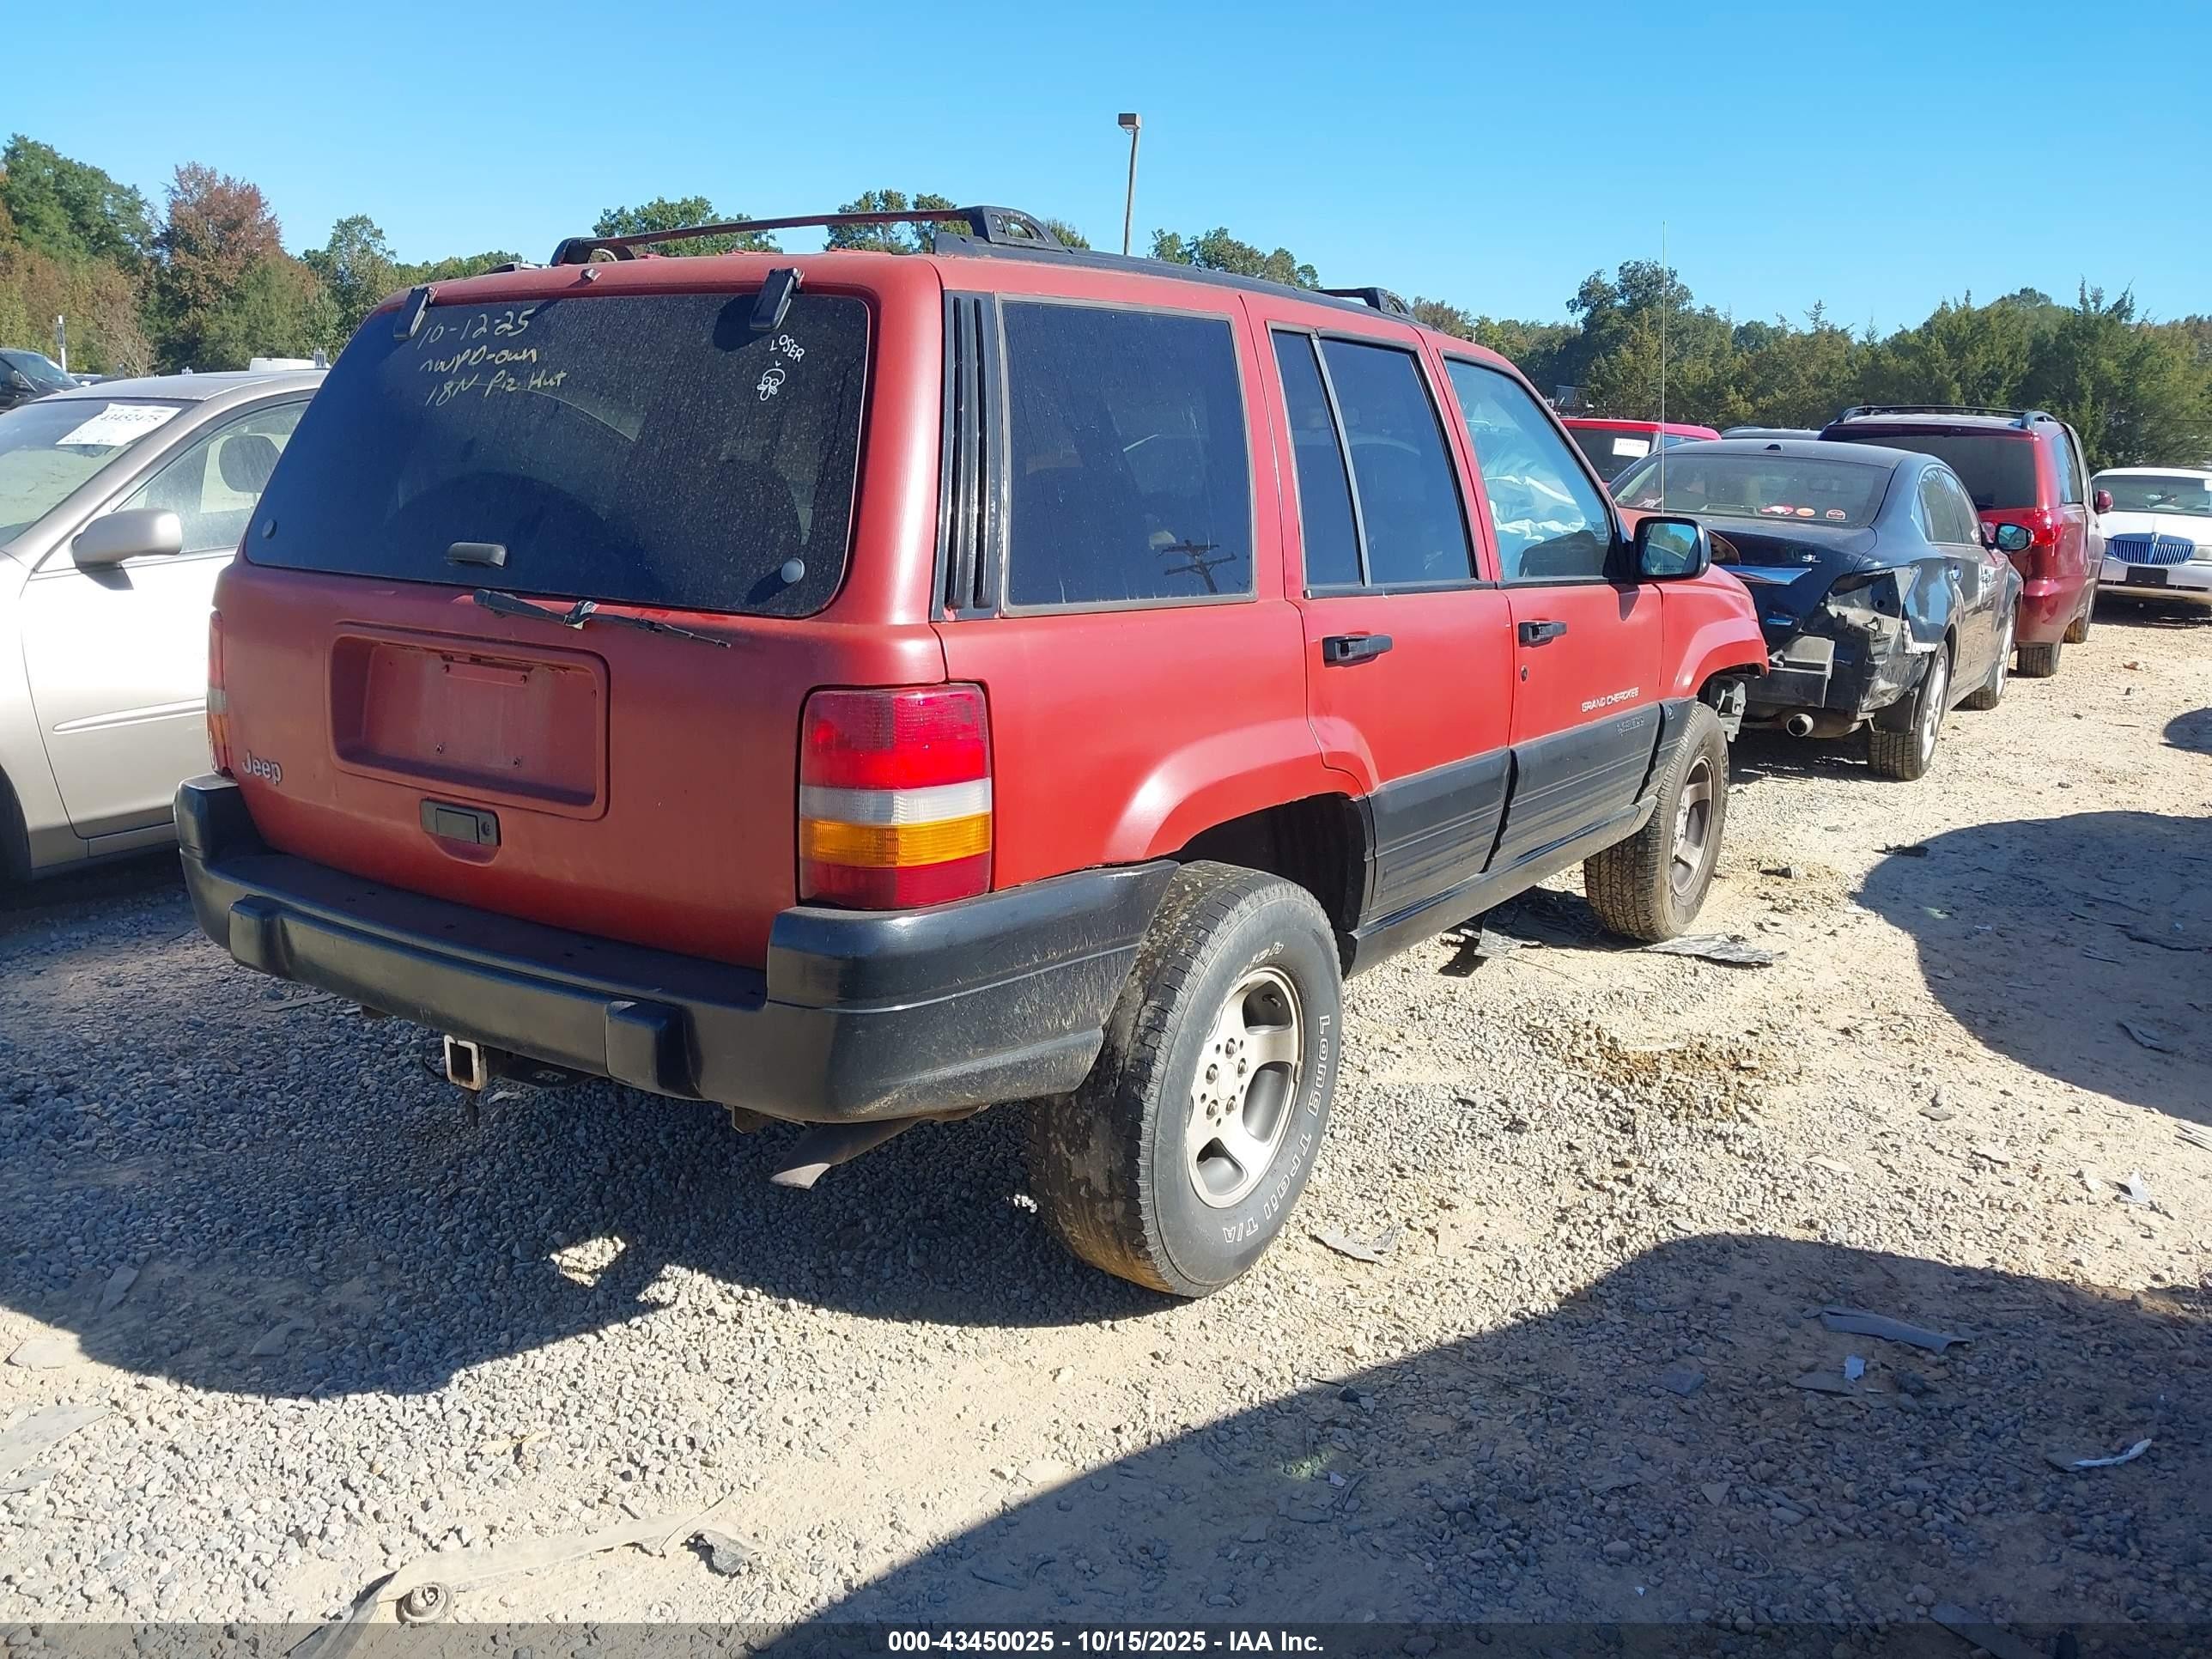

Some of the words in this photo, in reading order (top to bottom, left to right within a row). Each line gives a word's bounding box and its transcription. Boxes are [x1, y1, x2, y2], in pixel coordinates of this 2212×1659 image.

[417, 307, 536, 349] 10-12-25
[769, 334, 805, 362] LOSER
[1581, 696, 1607, 713] GRAND
[1606, 687, 1639, 705] CHEROKEE
[241, 750, 283, 786] Jeep
[1263, 1133, 1312, 1220] Trail
[1222, 1216, 1260, 1244] T/A
